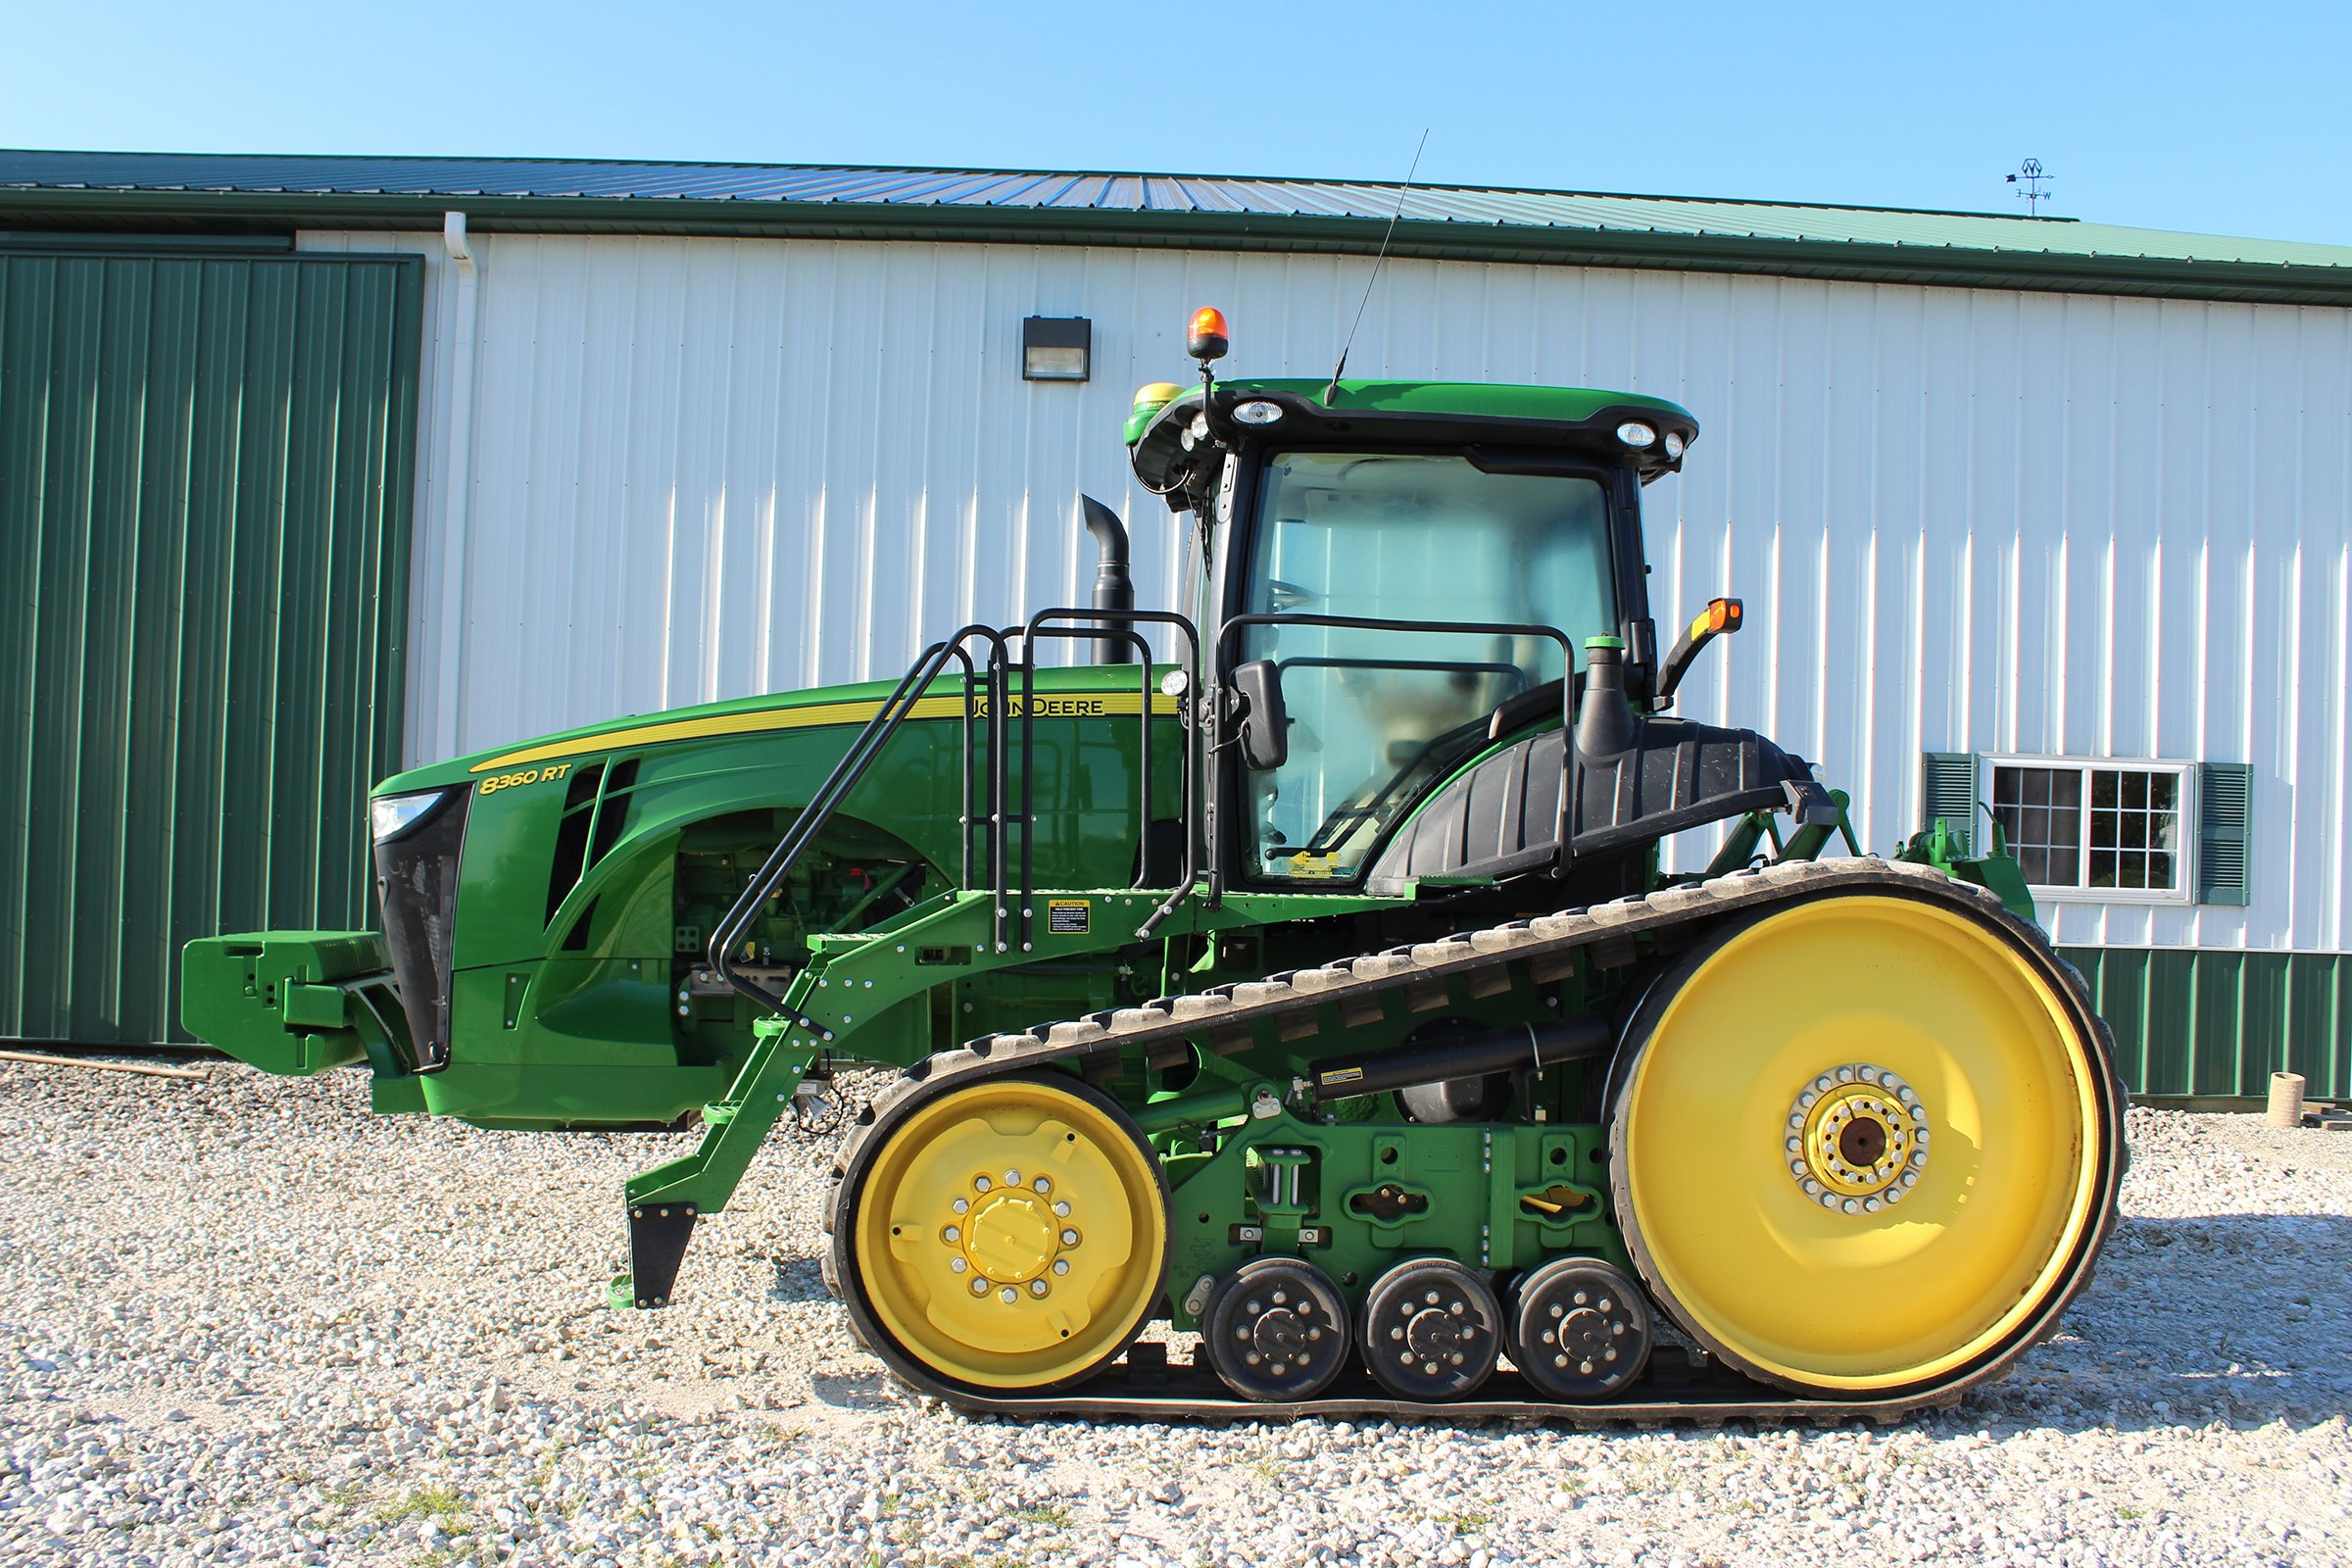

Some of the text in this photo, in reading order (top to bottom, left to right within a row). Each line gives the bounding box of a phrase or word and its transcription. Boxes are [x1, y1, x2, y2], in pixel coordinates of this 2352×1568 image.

[973, 698, 1103, 715] JON DEERE
[479, 763, 572, 795] 8360 RT
